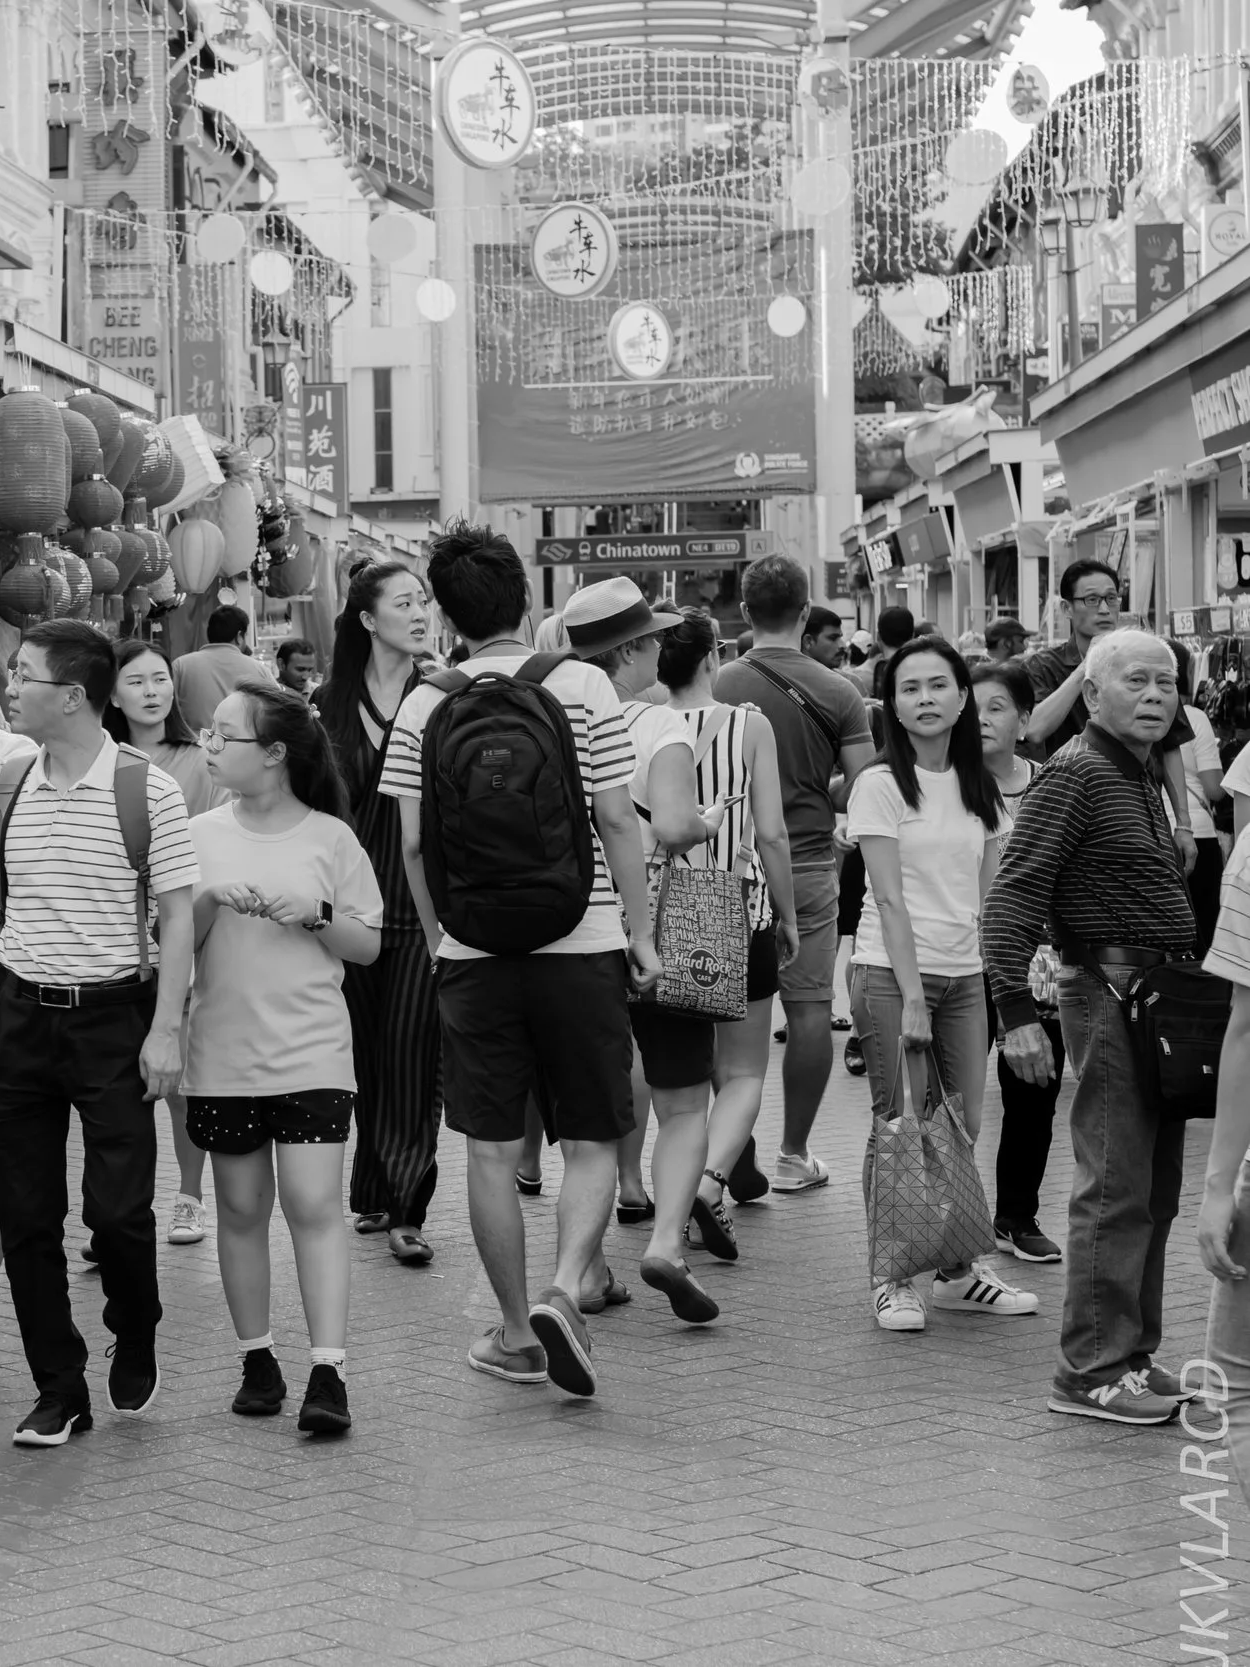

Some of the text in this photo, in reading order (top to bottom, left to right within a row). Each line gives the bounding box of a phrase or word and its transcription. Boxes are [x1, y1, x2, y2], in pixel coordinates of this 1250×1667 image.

[490, 57, 520, 150] 牛车水
[569, 213, 598, 284] 牛车水
[104, 306, 141, 327] BEE
[89, 336, 158, 358] CHENG
[596, 542, 681, 558] Chinatown
[690, 871, 714, 882] PARIS
[675, 952, 705, 970] Hard
[704, 957, 732, 978] Rock
[696, 973, 713, 983] CAFE
